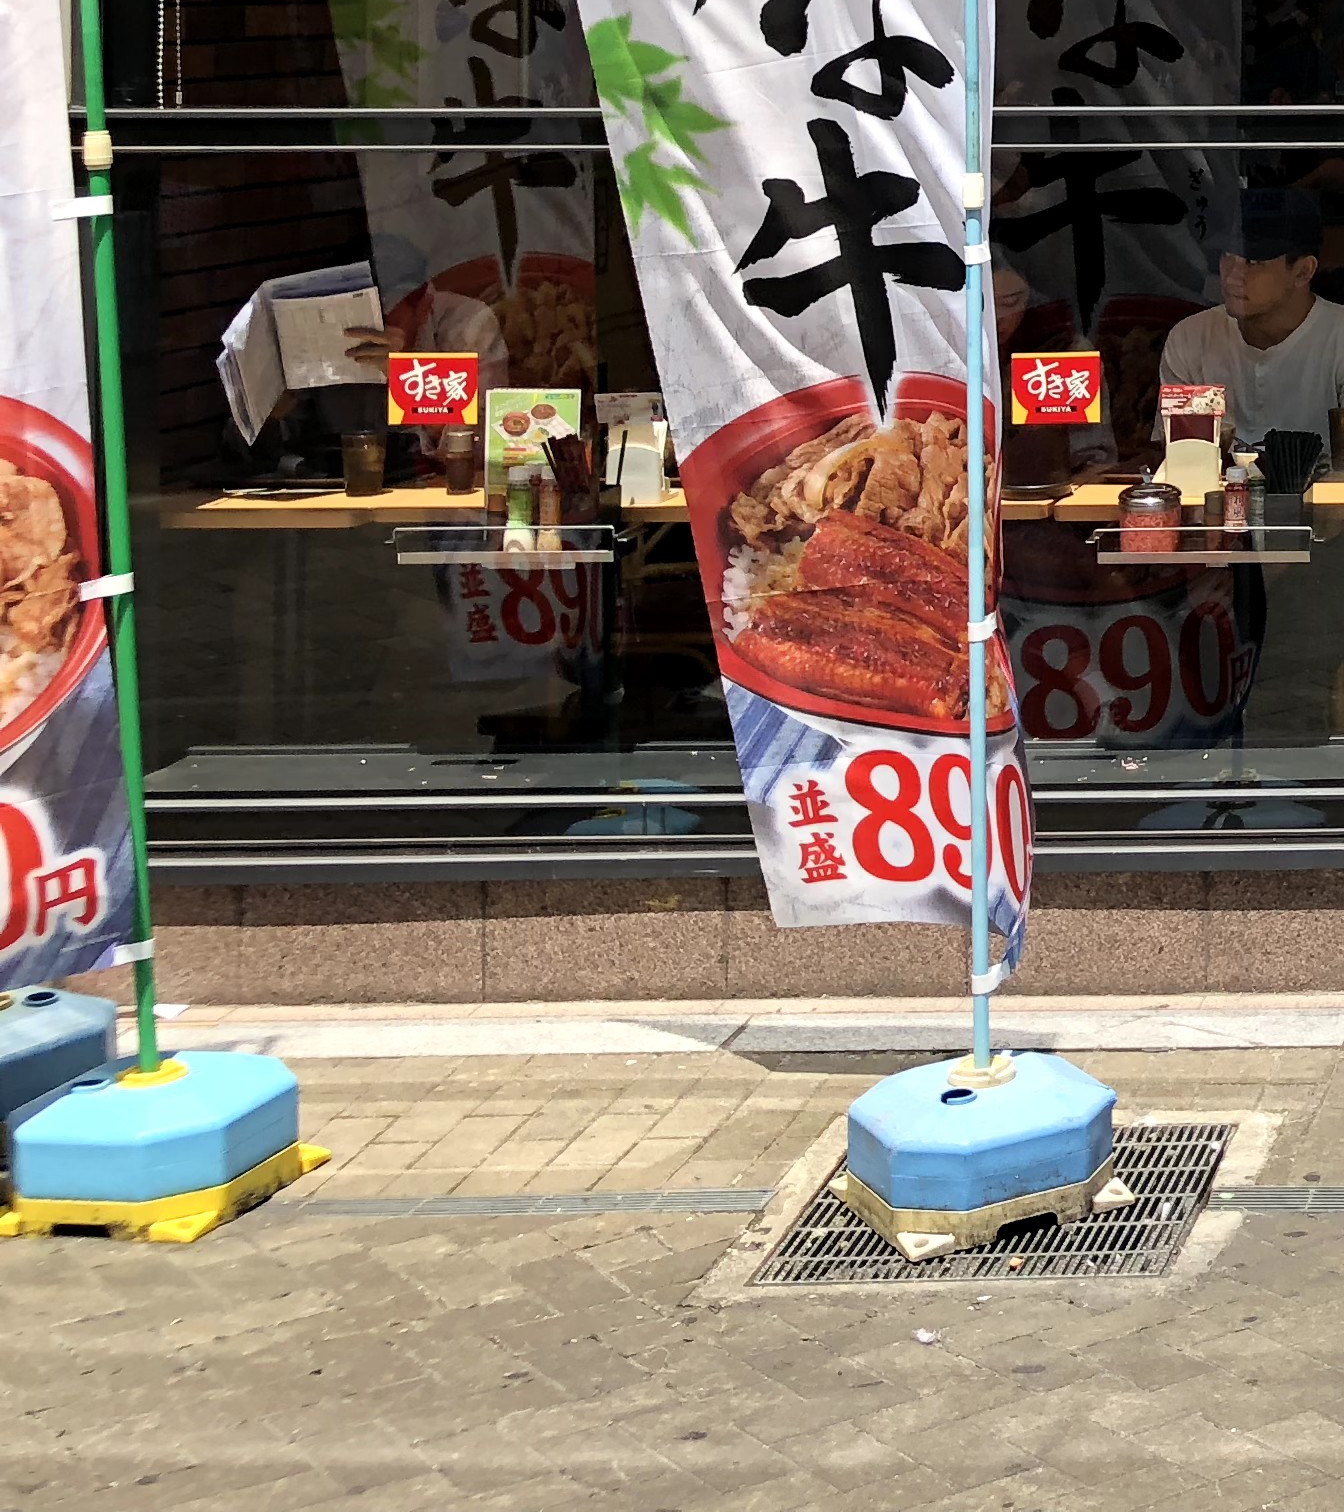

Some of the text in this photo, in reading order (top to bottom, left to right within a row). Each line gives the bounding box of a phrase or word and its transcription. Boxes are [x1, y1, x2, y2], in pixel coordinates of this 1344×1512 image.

[398, 358, 470, 407] すき家
[1020, 358, 1092, 406] すき家
[416, 406, 452, 415] SUKIYA
[1039, 405, 1074, 415] SUKIYA
[788, 779, 849, 884] 並盛
